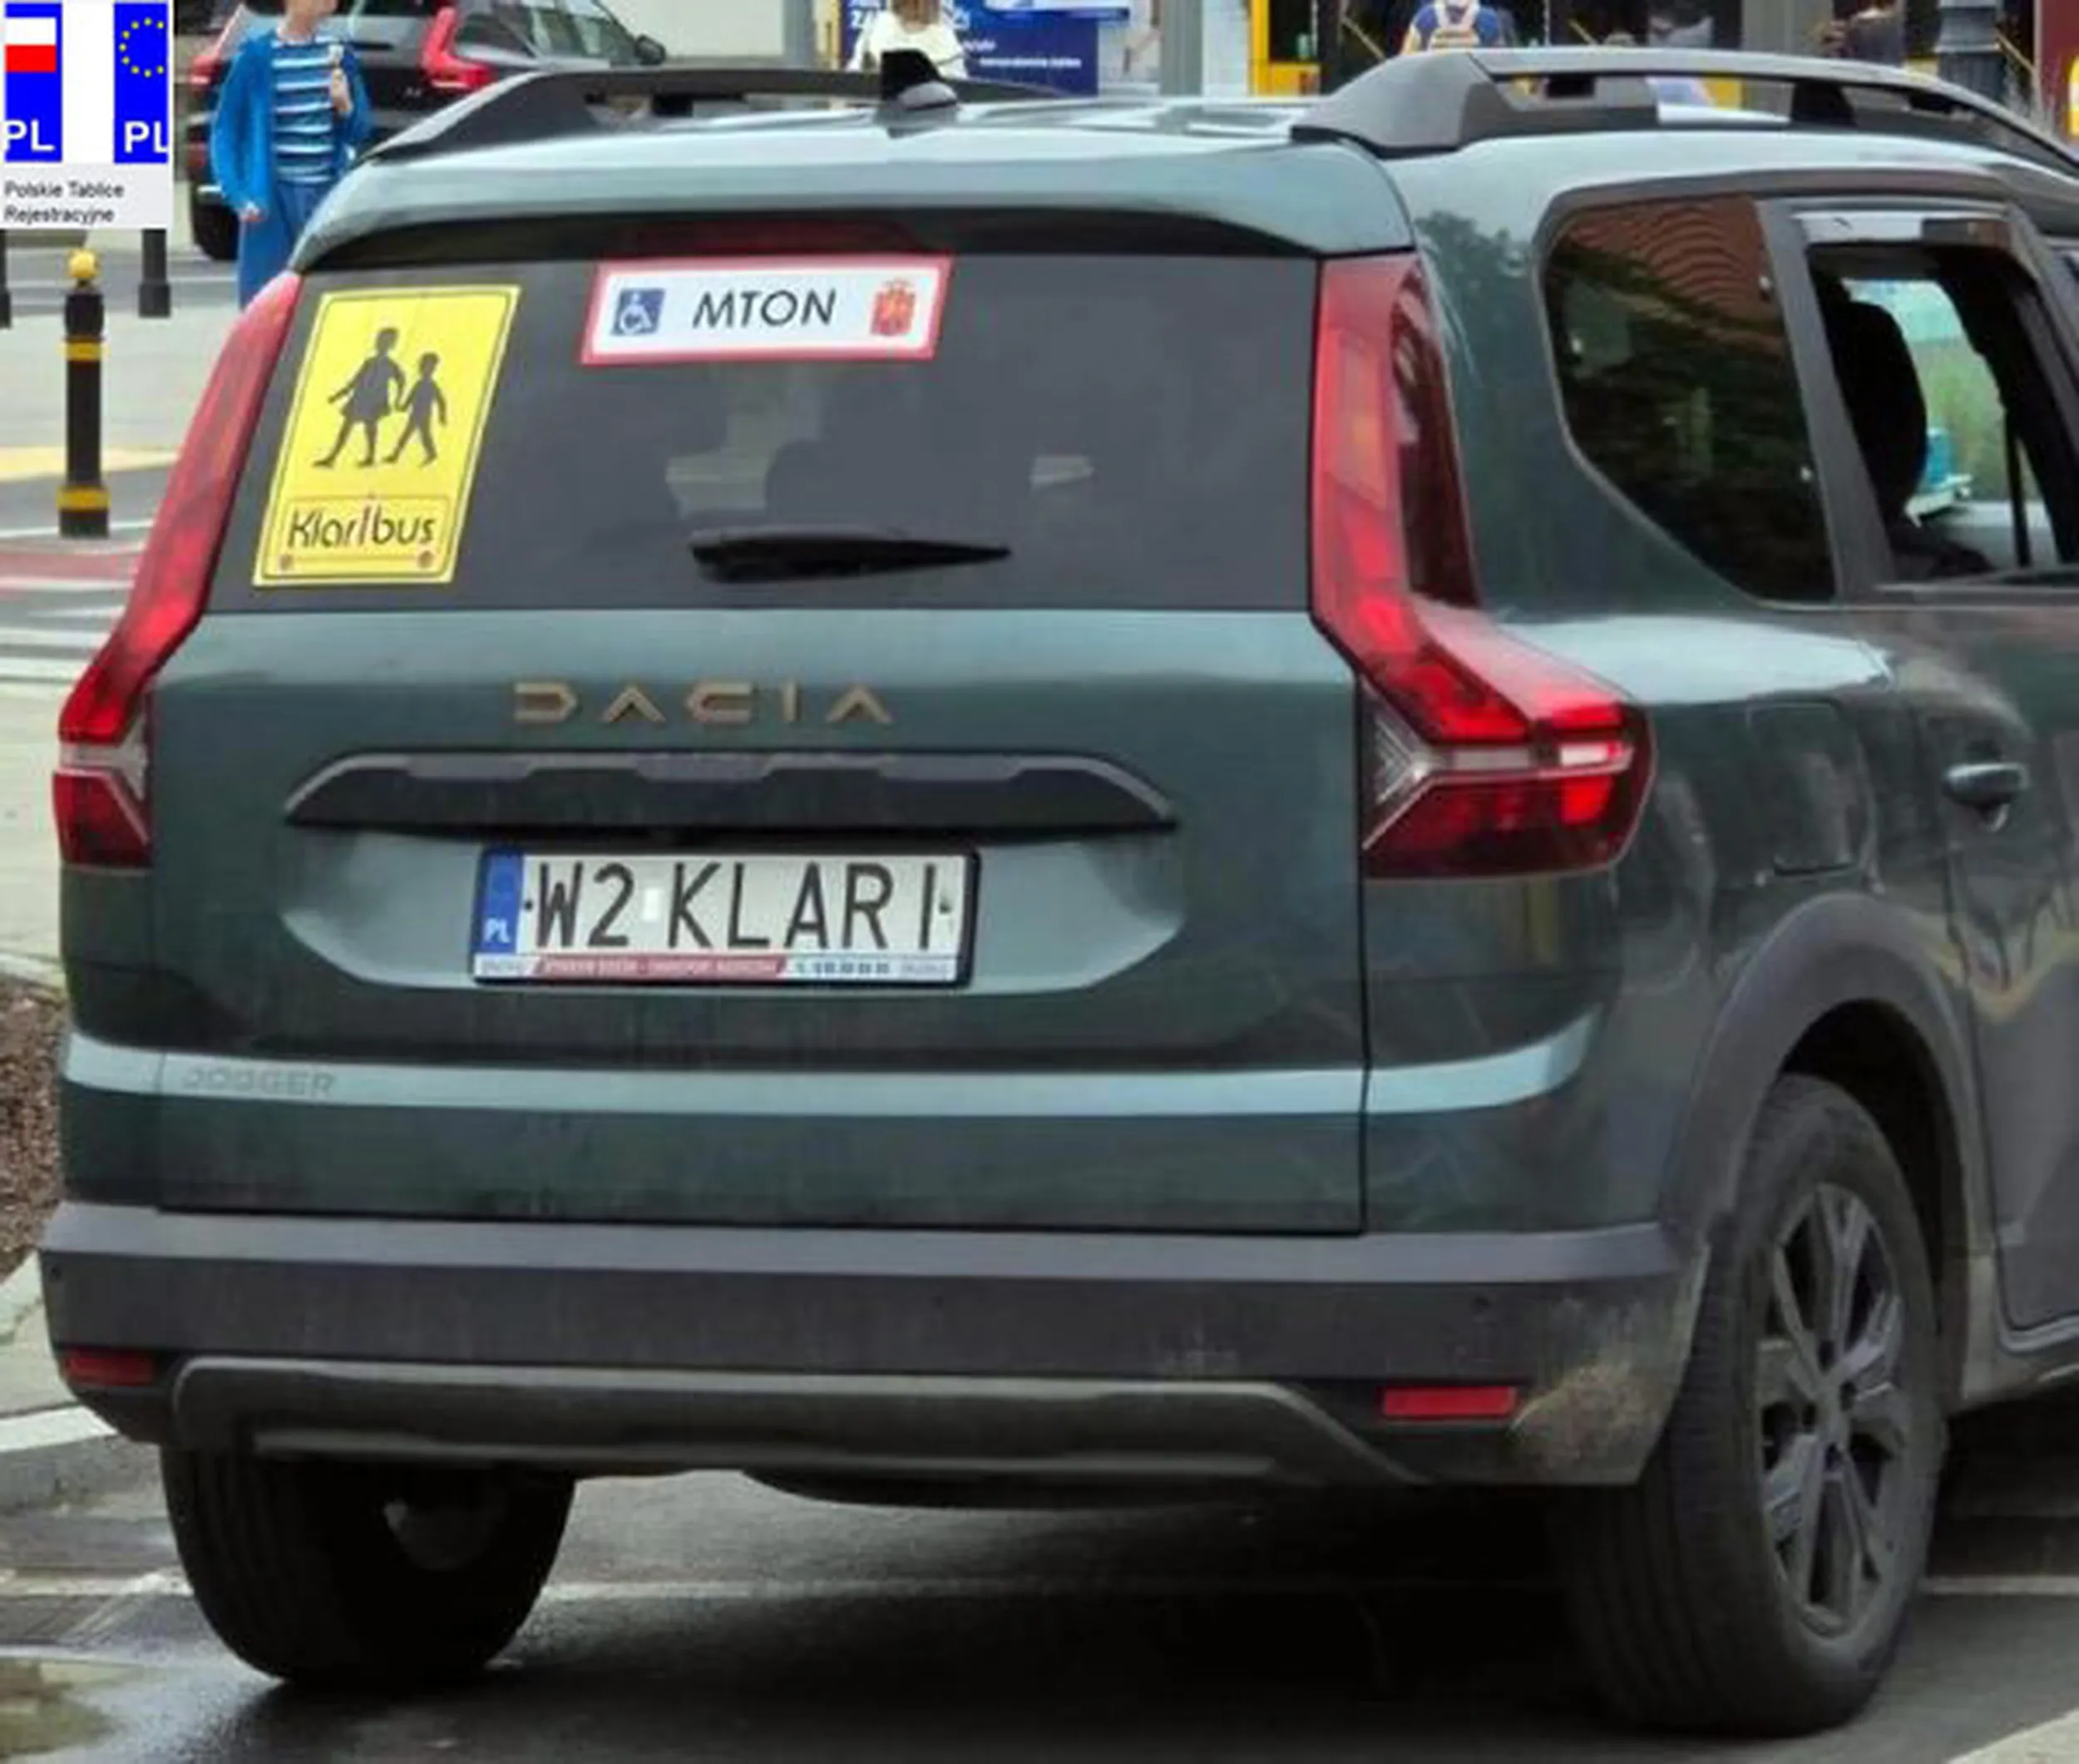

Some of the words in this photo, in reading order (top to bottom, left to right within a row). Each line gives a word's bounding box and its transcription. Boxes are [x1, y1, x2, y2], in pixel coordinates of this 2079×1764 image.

[692, 289, 836, 329] MTON
[513, 681, 893, 725] DACIA
[536, 862, 635, 949] W2
[667, 862, 935, 950] KLARI
